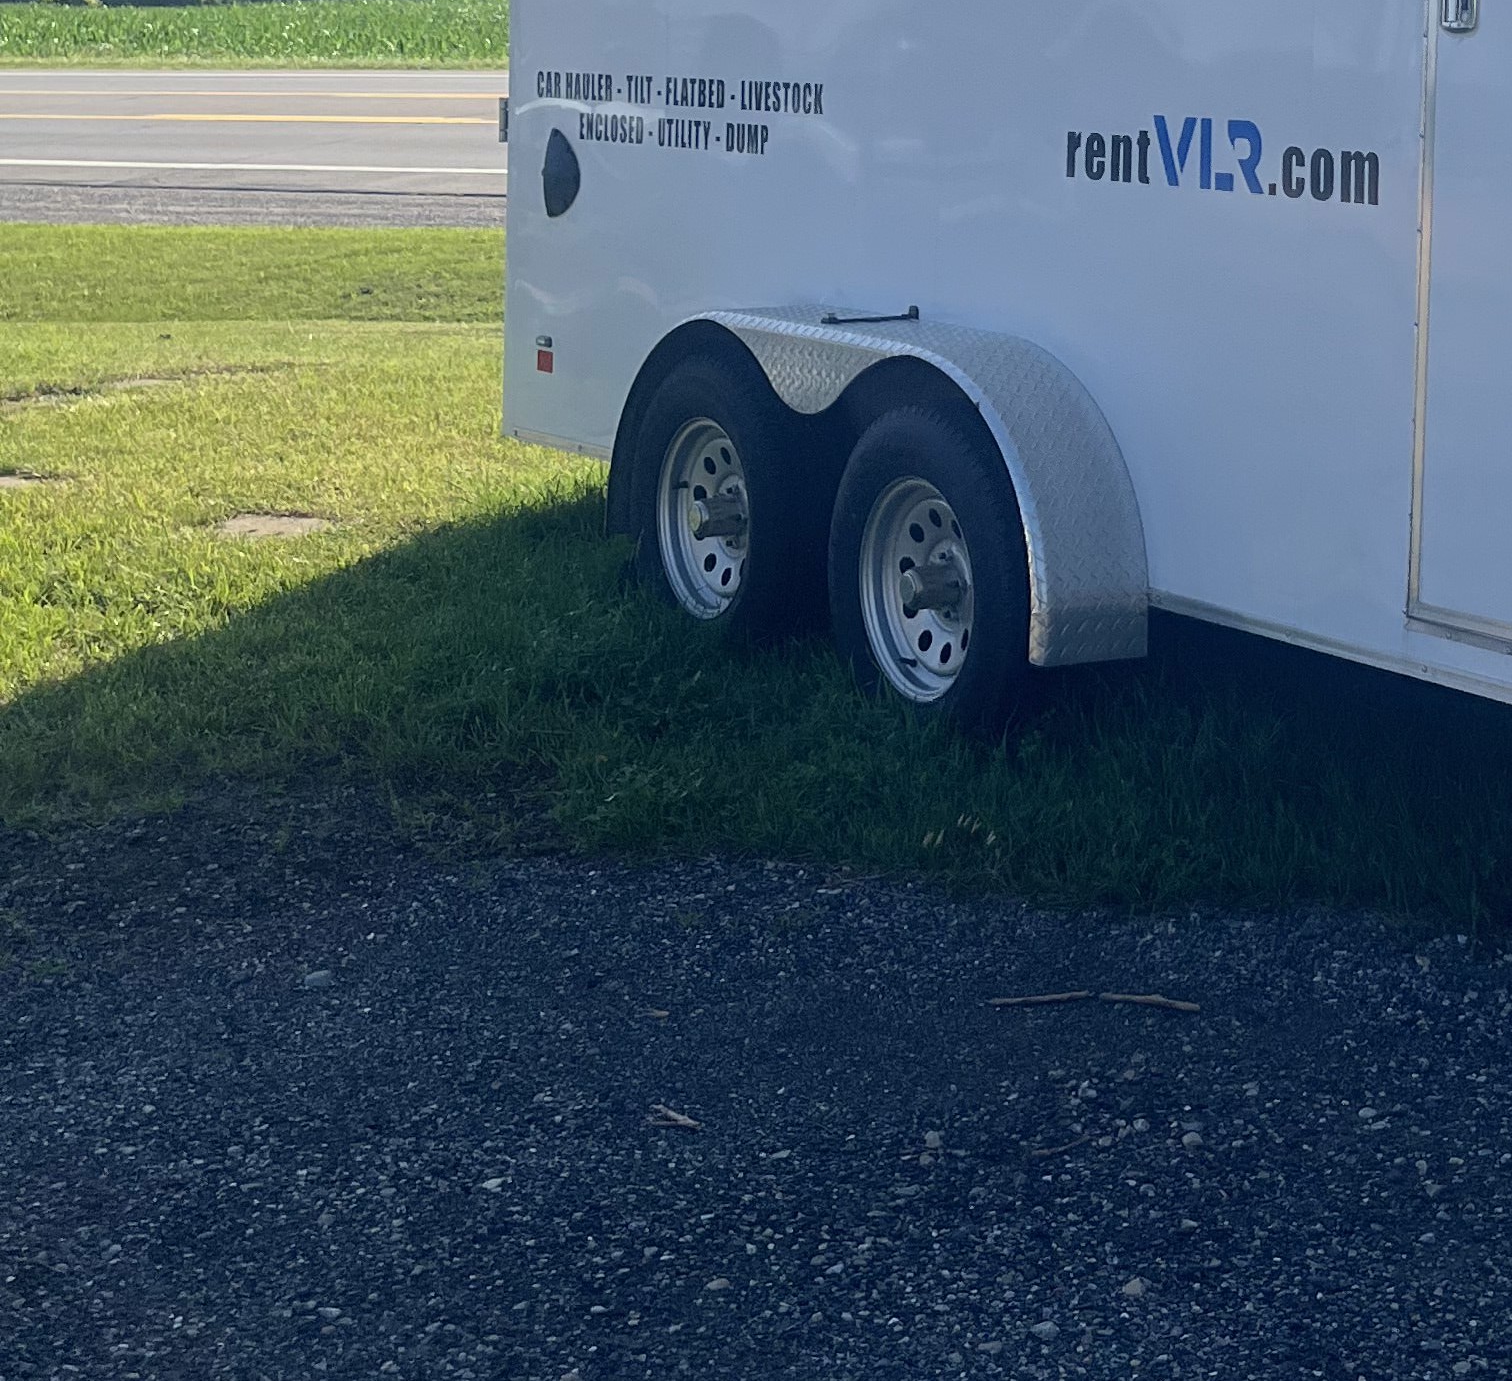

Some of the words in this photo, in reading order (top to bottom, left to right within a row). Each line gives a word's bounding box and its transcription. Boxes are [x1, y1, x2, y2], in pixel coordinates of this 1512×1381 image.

[536, 70, 561, 99] CAR
[565, 72, 613, 102] HAULER
[625, 74, 653, 104] TILT
[665, 76, 725, 109] FLATBED
[740, 80, 824, 115] LIVESTOCK
[579, 112, 644, 145] ENCLOSED
[657, 117, 712, 151] UTILITY
[725, 122, 769, 155] DUMP
[1065, 114, 1380, 206] rentVLR.com
